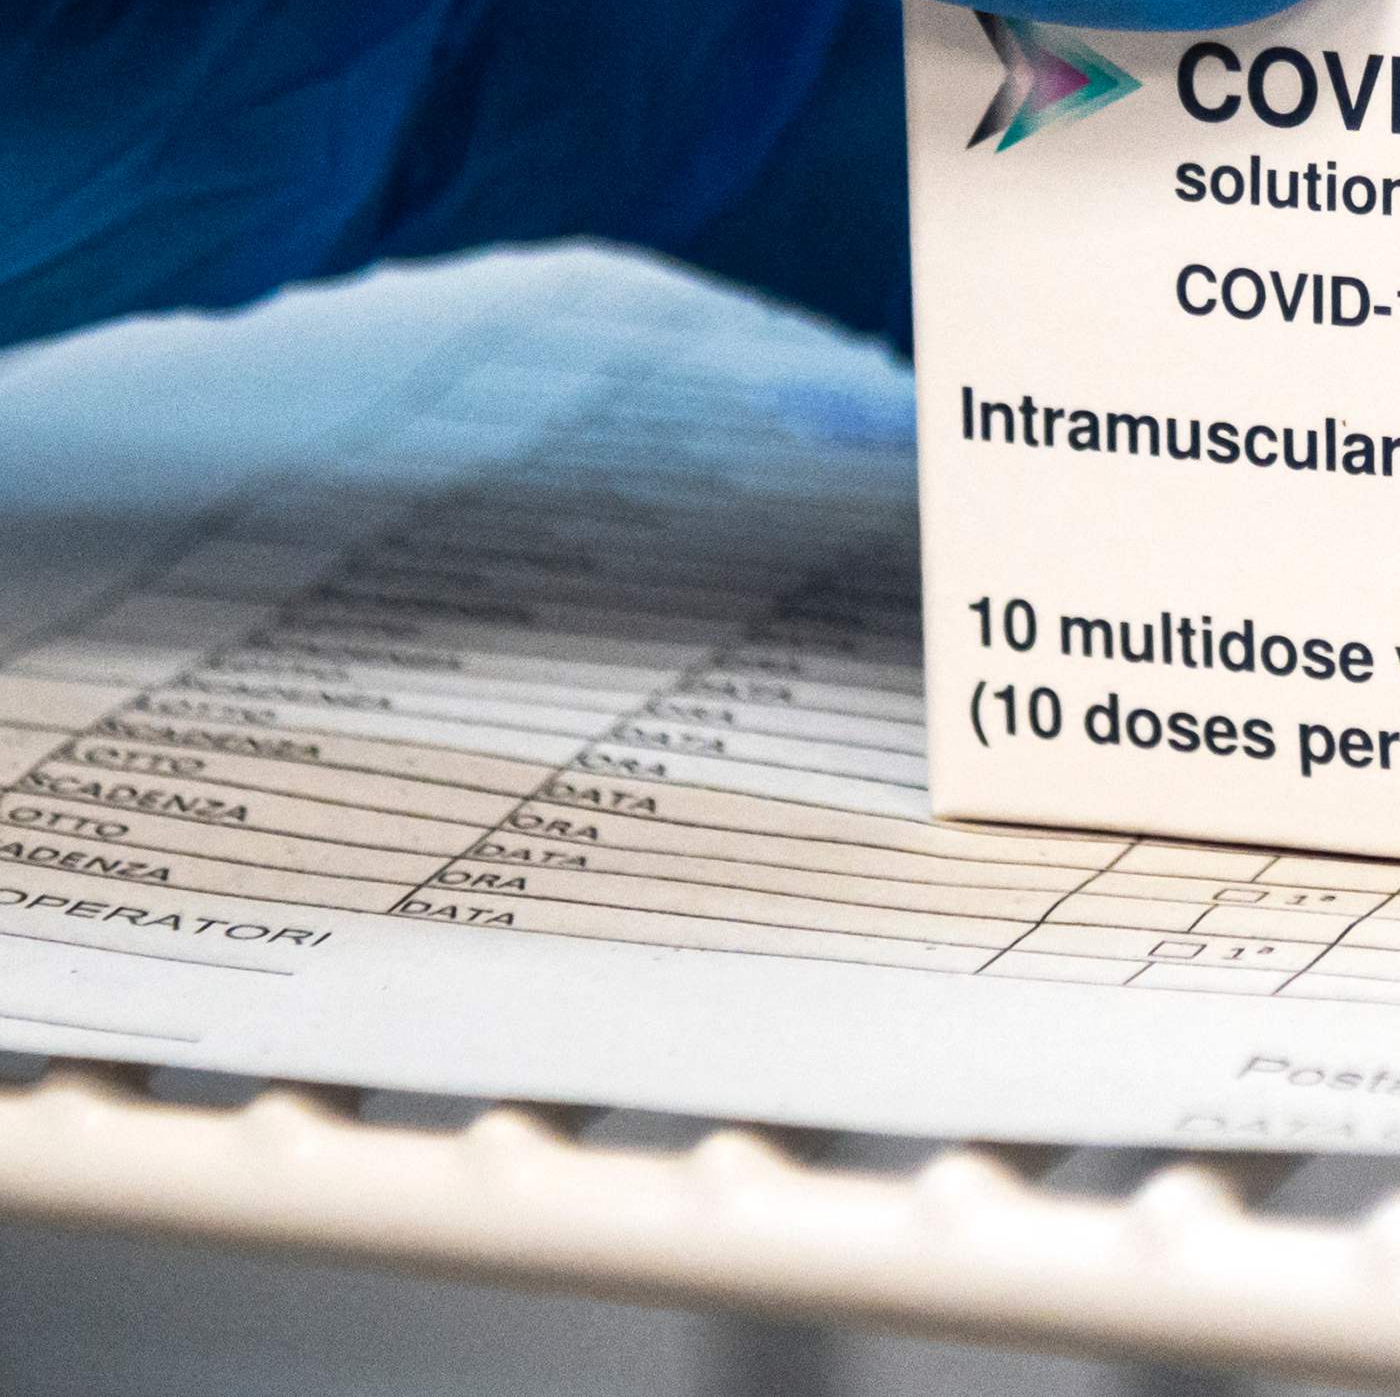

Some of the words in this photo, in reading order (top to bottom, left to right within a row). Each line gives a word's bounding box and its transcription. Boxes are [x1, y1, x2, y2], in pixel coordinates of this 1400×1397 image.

[968, 595, 1037, 653] 10
[1058, 610, 1375, 684] multidose
[968, 679, 1064, 747] (10
[1083, 692, 1277, 761] doses
[1299, 721, 1400, 777] per
[510, 813, 599, 841] ORA
[474, 842, 588, 868] DATA
[436, 870, 526, 891] ORA
[0, 887, 333, 948] OPERATORI
[399, 900, 515, 926] DATA
